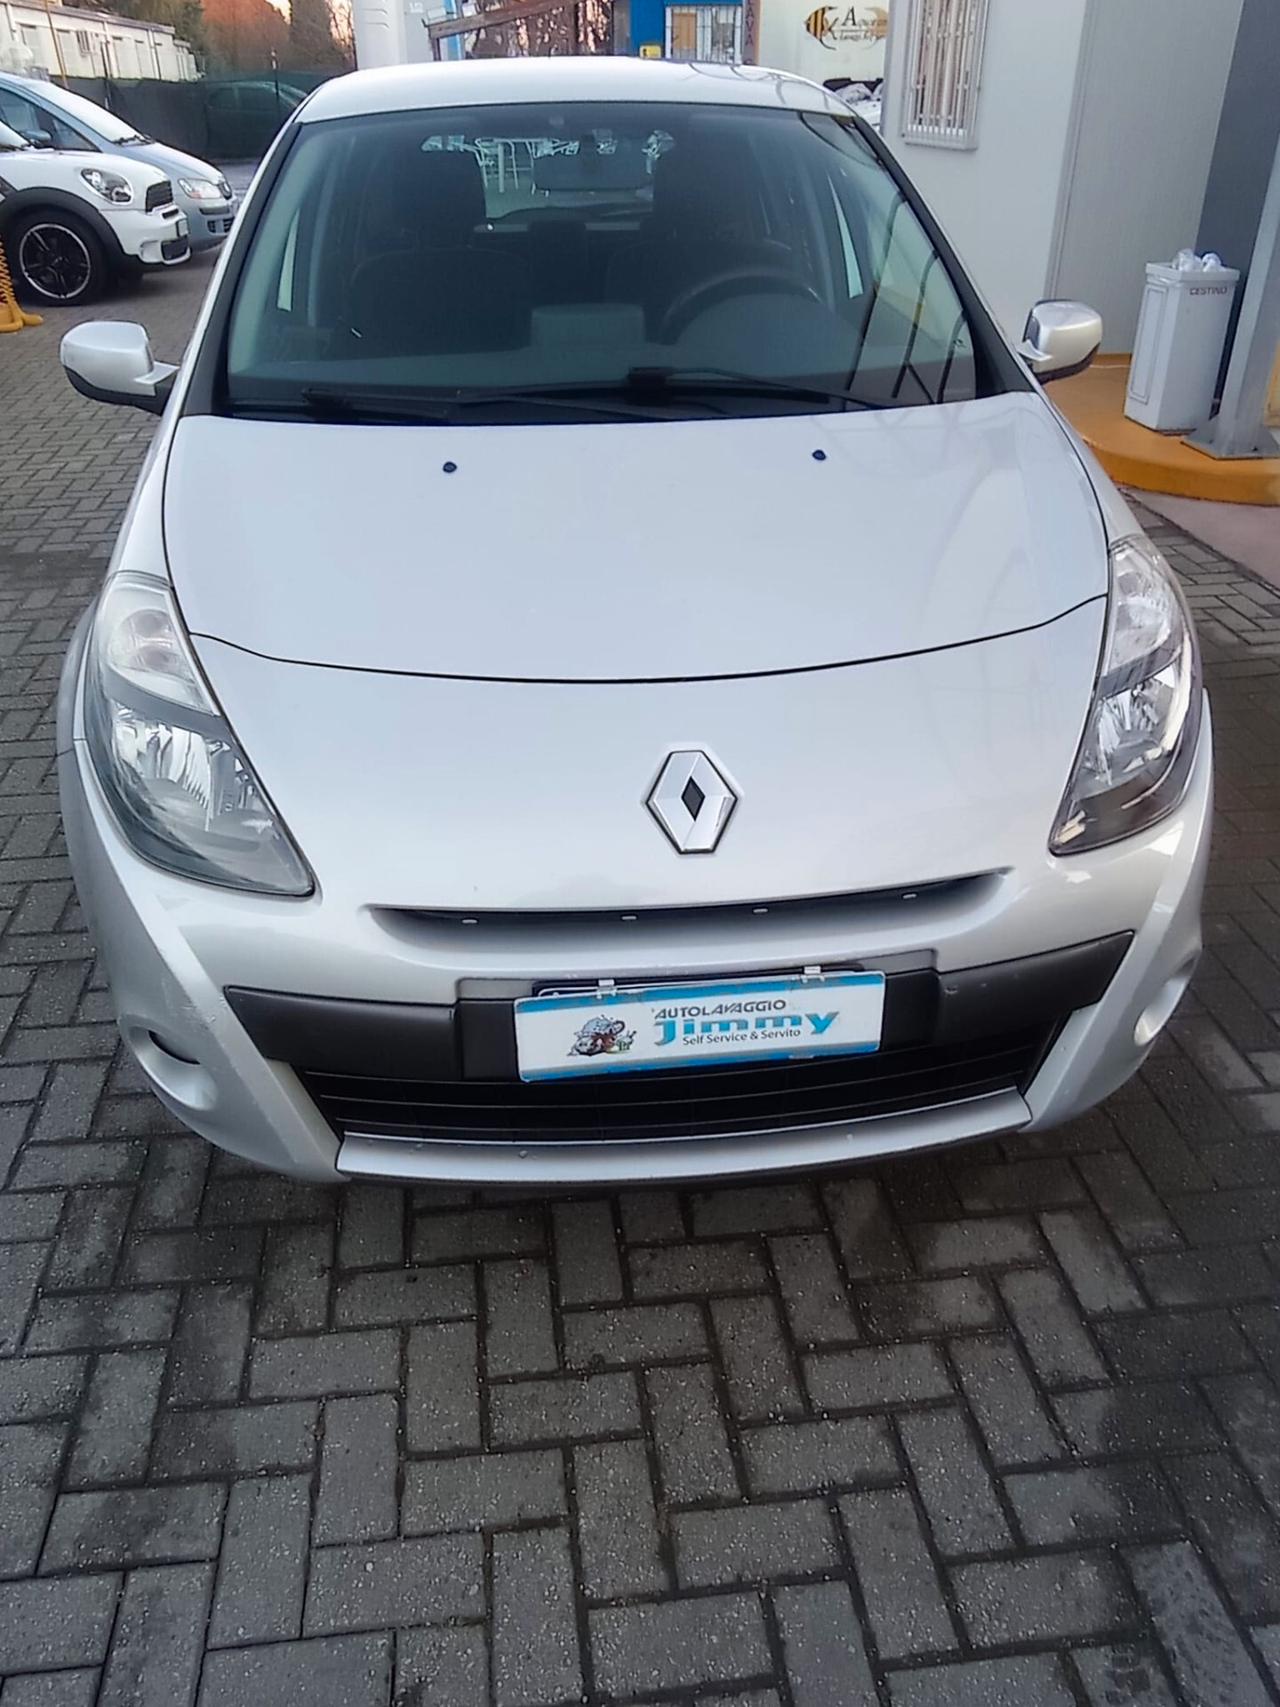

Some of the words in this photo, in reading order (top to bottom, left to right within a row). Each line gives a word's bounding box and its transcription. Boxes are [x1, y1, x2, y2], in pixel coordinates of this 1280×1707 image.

[1189, 286, 1228, 295] CESTINO
[654, 999, 787, 1019] AUTOLAVAGGIO
[682, 1032, 704, 1046] Self
[706, 1030, 748, 1043] Service
[749, 1030, 760, 1040] &
[761, 1028, 801, 1039] Servito
